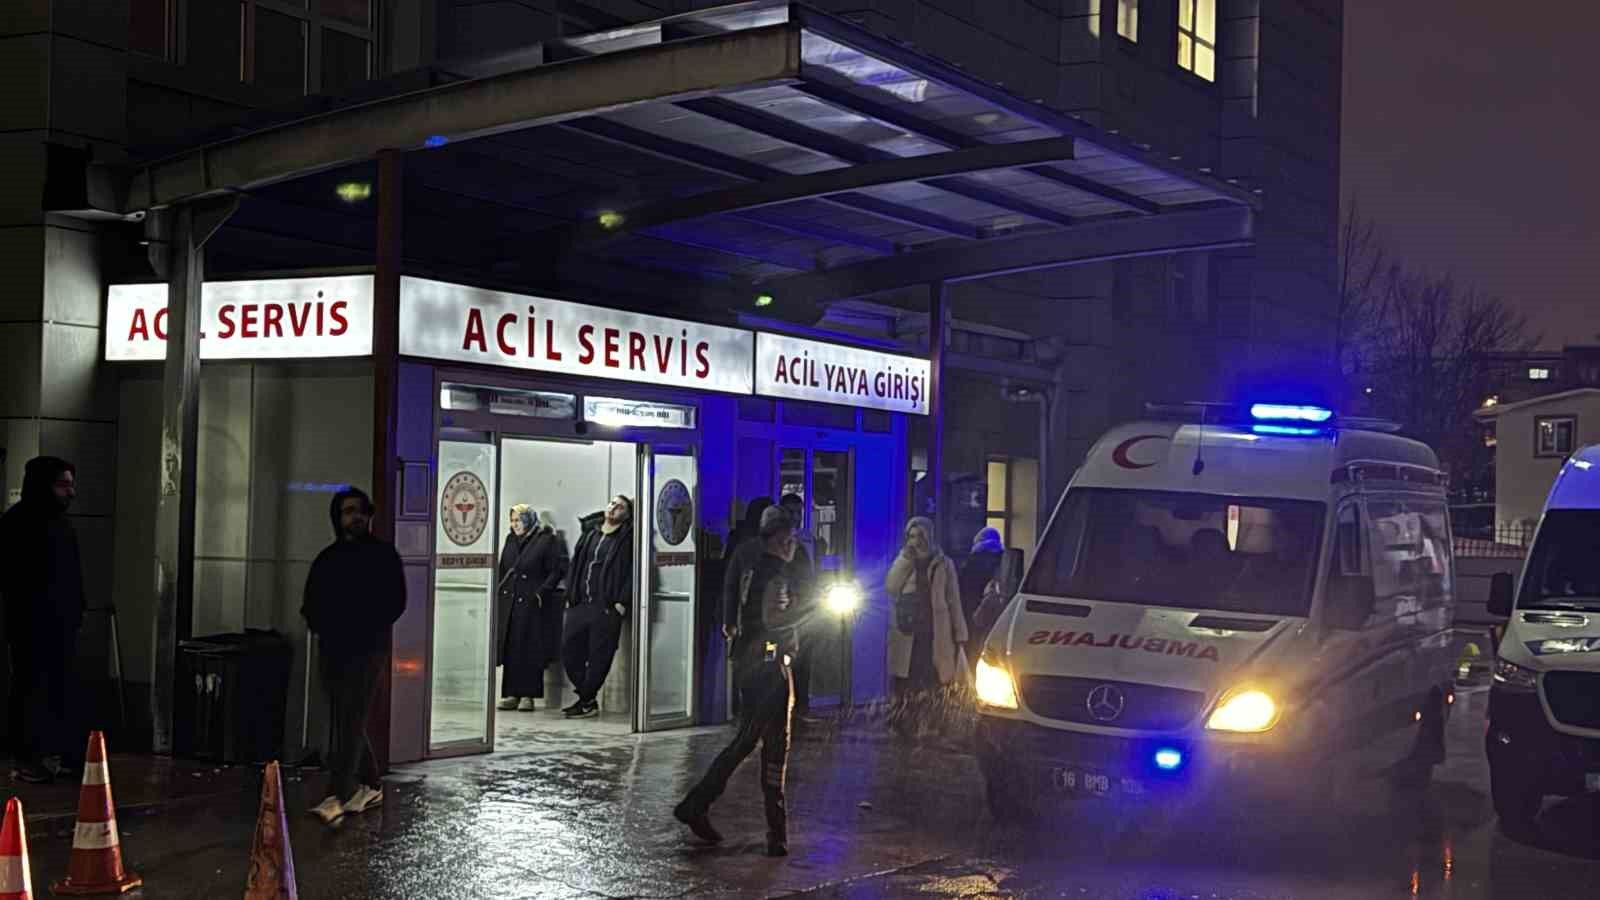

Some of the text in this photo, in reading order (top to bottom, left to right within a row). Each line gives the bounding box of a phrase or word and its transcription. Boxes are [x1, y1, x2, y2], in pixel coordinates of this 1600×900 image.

[128, 290, 349, 341] AC SERVİS
[462, 305, 710, 379] ACİL SERVİS
[775, 350, 925, 408] ACİL YAYA GİRİŞİ
[1062, 770, 1076, 787] 16
